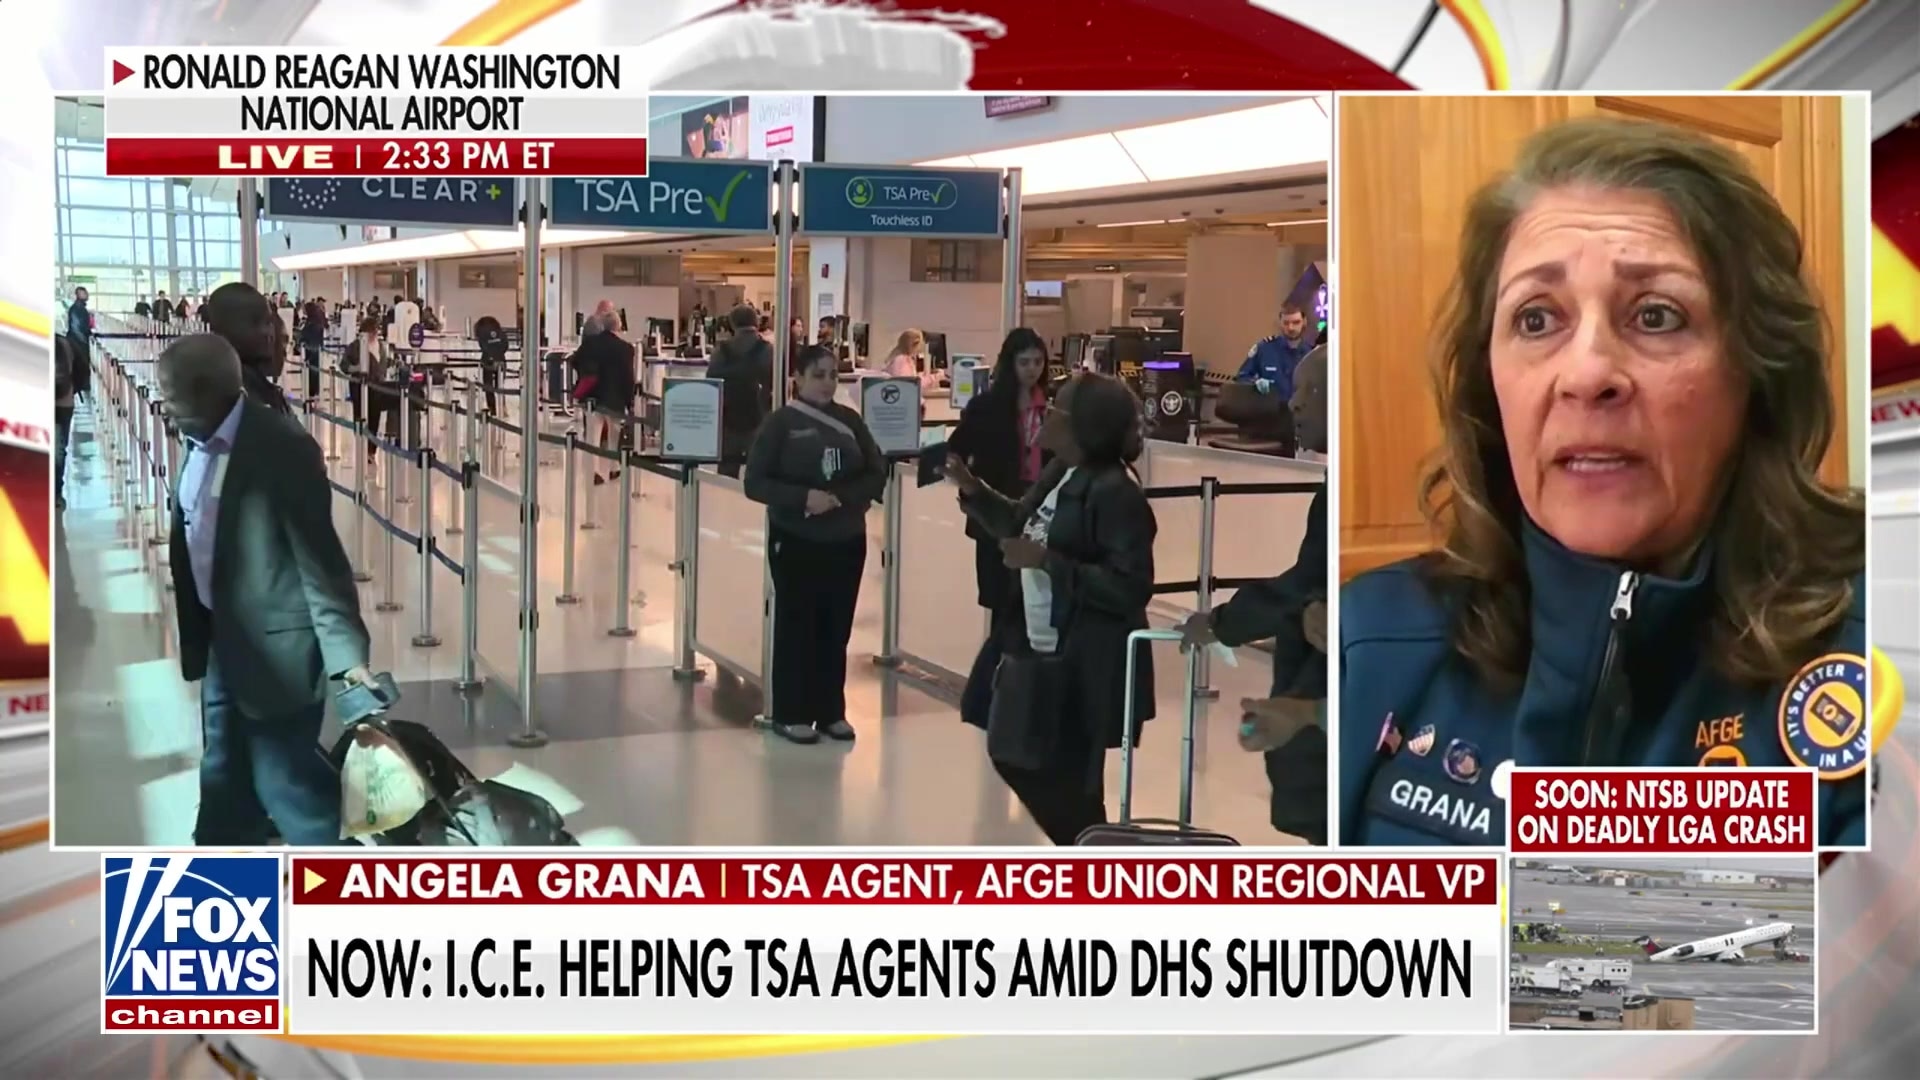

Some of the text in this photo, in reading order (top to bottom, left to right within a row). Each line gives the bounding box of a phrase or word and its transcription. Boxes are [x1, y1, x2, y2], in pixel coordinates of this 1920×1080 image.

[575, 178, 640, 213] TSA
[884, 186, 906, 201] TSA
[871, 214, 933, 226] Touchless ID
[1792, 664, 1845, 702] BETTER
[1695, 713, 1744, 748] AFGE
[1787, 706, 1799, 738] IT'S
[1819, 753, 1837, 767] IN
[1843, 749, 1854, 764] A
[1390, 779, 1491, 835] GRANA
